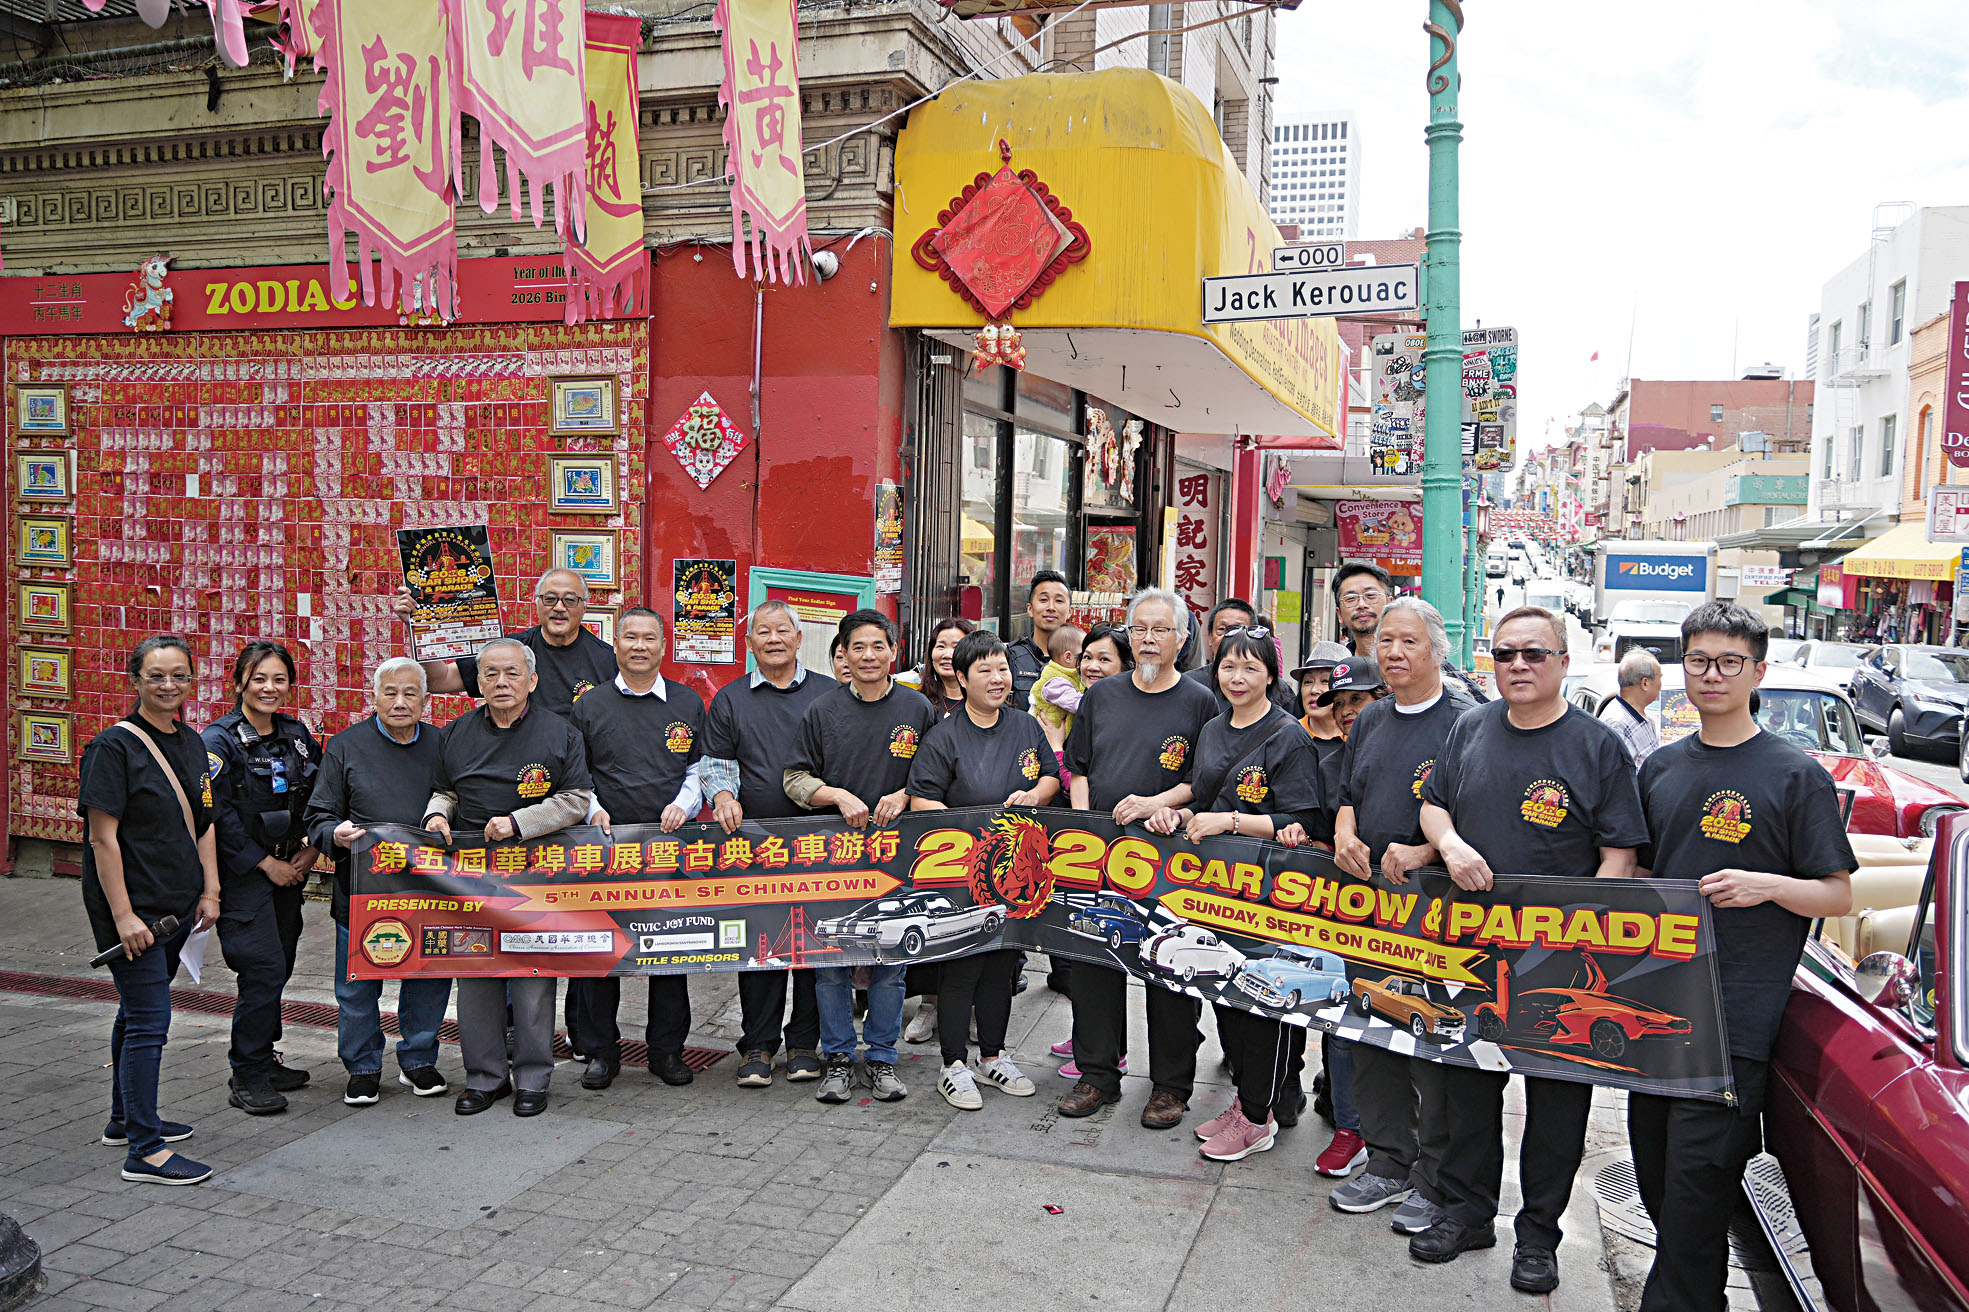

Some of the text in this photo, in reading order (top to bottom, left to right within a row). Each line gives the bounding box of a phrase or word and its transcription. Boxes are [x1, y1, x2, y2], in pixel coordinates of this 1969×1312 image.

[1299, 247, 1338, 266] 000
[514, 267, 536, 279] Year
[539, 266, 549, 278] of
[33, 282, 81, 298] 十二生肖
[1214, 278, 1408, 312] Jack Kerouac
[512, 293, 541, 304] 2026
[33, 305, 84, 321] 丙午馬年
[1405, 339, 1424, 347] OBOE
[682, 406, 722, 450] 福
[1339, 501, 1399, 513] Convenience
[429, 569, 466, 578] 2026
[1640, 562, 1694, 579] Budget
[419, 576, 478, 586] CAR SHOW
[435, 584, 474, 592] PARADE
[517, 781, 551, 790] 2026
[1520, 799, 1567, 818] 2026
[1521, 809, 1563, 823] CAR SHOW
[1530, 816, 1559, 828] PARADE
[1700, 815, 1752, 833] 2026
[1701, 825, 1747, 839] CAR SHOW
[1711, 832, 1741, 844] PARADE
[372, 829, 901, 876] 第五屆華埠車展暨古典名車游行
[544, 877, 878, 904] 5TH ANNUAL SF CHINATOWN
[366, 899, 484, 912] PRESENTED BY
[1170, 851, 1700, 955] CAR SHOW & PARADE
[629, 916, 715, 932] CIVIC JOY FUND
[1182, 898, 1260, 928] SUNDAY,
[1266, 918, 1314, 938] SEPT
[1319, 928, 1330, 942] 6
[1336, 932, 1362, 948] ON
[1366, 938, 1424, 962] GRANT
[636, 953, 740, 966] TITLE SPONSORS
